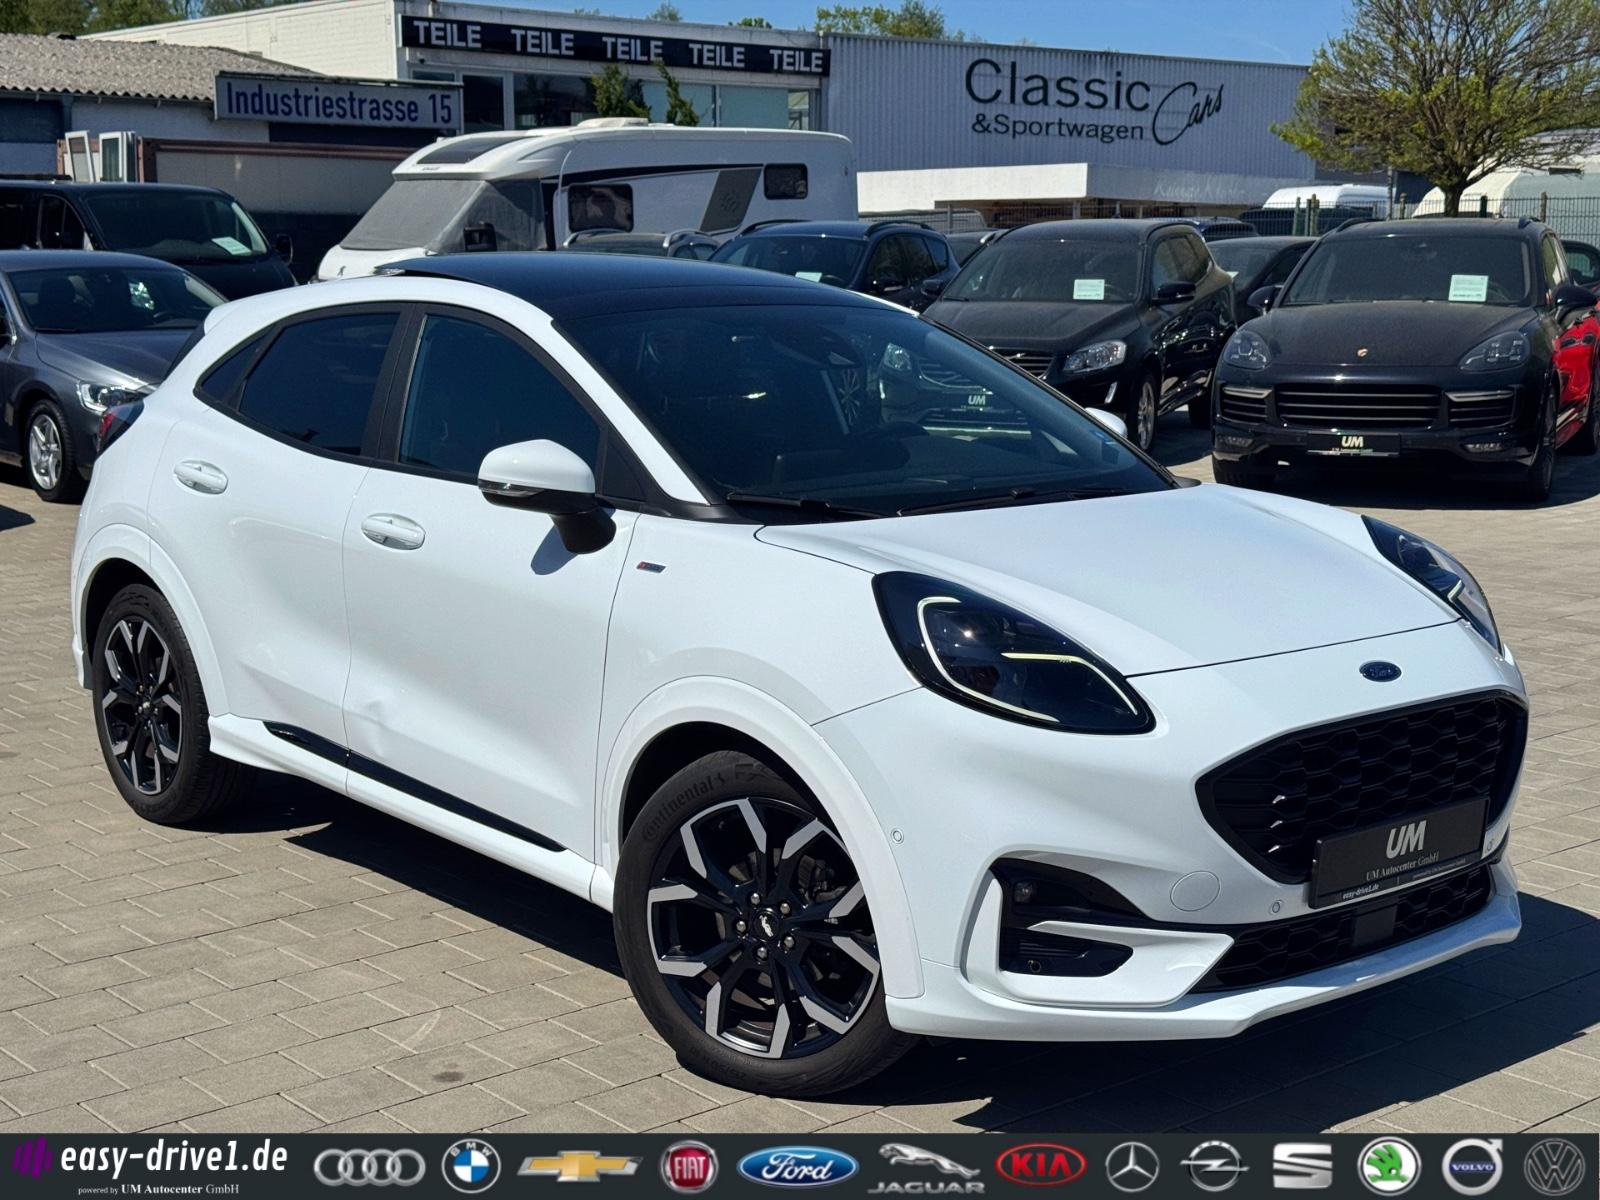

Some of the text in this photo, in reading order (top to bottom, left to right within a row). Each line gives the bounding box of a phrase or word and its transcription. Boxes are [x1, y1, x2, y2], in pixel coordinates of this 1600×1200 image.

[413, 20, 823, 72] TEILE TEILE TEILE TEILE TEILE
[227, 82, 452, 124] Industriestrasse 15
[965, 58, 1150, 111] Classic
[971, 113, 1144, 143] &Sportwagen
[1152, 81, 1224, 145] Cars
[1341, 436, 1364, 447] UM
[1386, 820, 1427, 859] UM
[1380, 860, 1417, 877] Autocenter
[1418, 852, 1439, 867] GmbH
